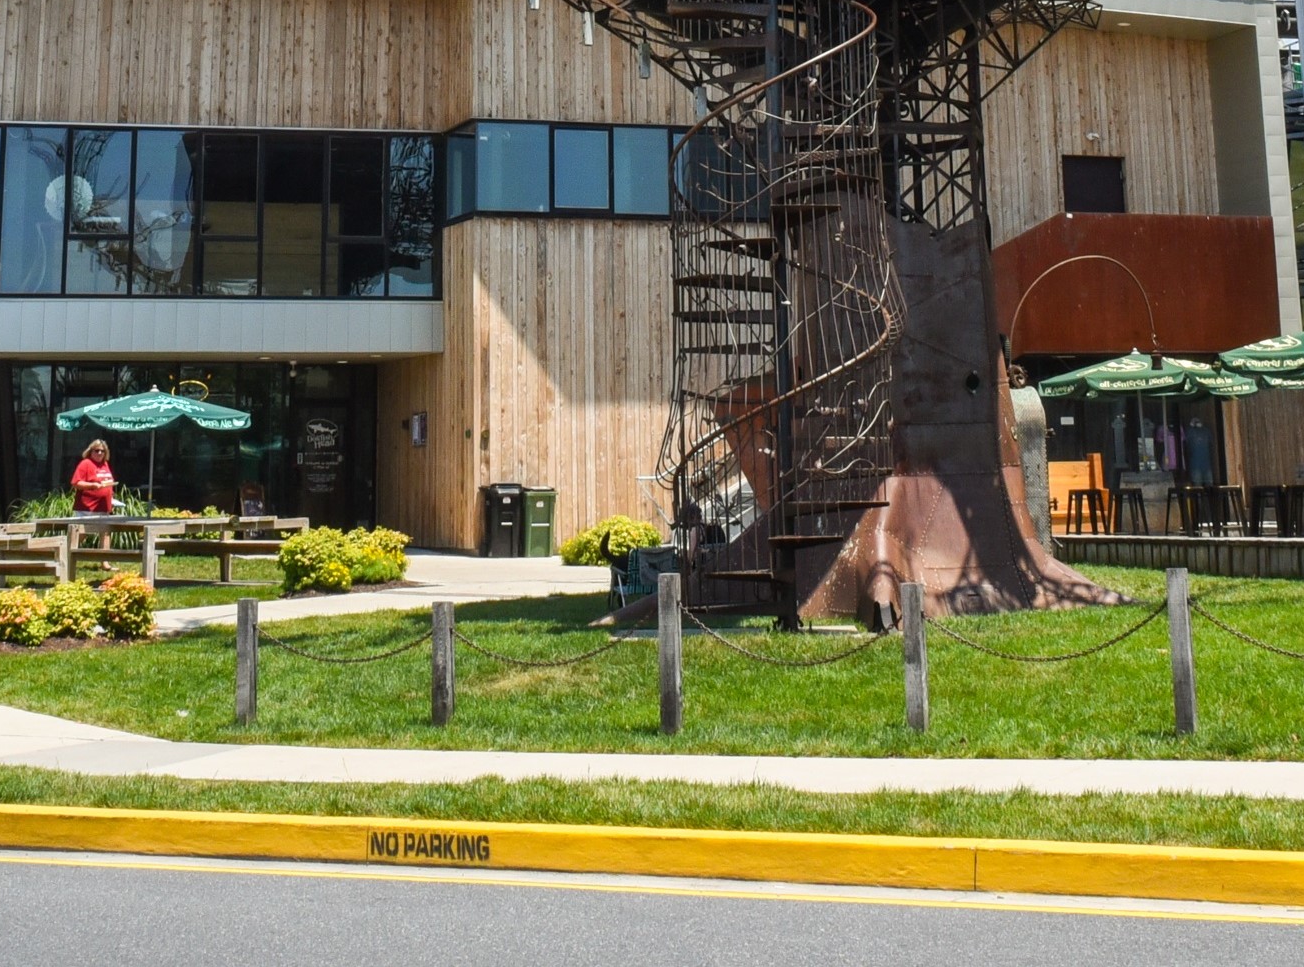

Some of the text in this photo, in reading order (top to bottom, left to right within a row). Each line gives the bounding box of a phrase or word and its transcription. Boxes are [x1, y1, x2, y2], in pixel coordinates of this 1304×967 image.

[1099, 379, 1146, 388] off-centered
[370, 831, 490, 862] NO PARKING
